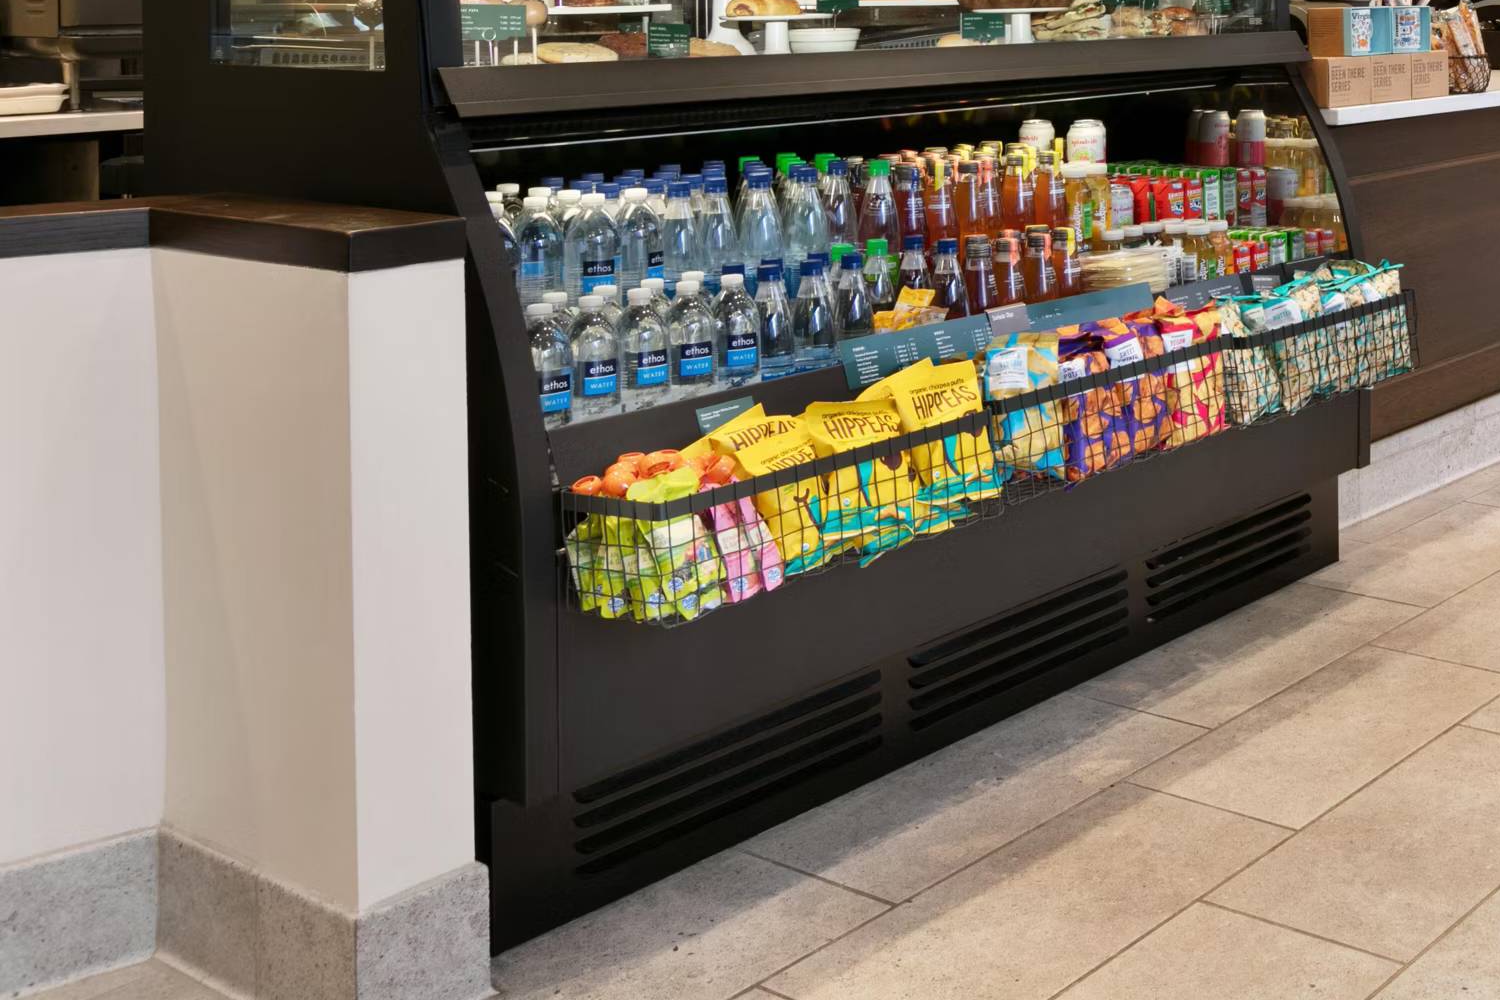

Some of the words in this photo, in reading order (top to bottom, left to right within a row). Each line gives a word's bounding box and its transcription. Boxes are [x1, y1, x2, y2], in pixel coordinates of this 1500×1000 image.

[651, 254, 664, 264] etho
[587, 263, 612, 273] ethos
[732, 337, 754, 347] ethos
[685, 346, 709, 356] ethos
[642, 354, 665, 364] ethos
[733, 353, 754, 361] WATER
[590, 363, 614, 375] ethos
[686, 362, 709, 370] WATER
[643, 371, 665, 379] WATER
[544, 380, 568, 391] ethos
[590, 381, 613, 390] WATER
[909, 386, 928, 394] organic
[929, 382, 950, 391] chickpea
[950, 378, 964, 386] puffs
[544, 397, 567, 407] WATER
[912, 385, 977, 420] HIPPEAS
[822, 410, 843, 419] organic
[823, 414, 900, 440] HIPPEAS
